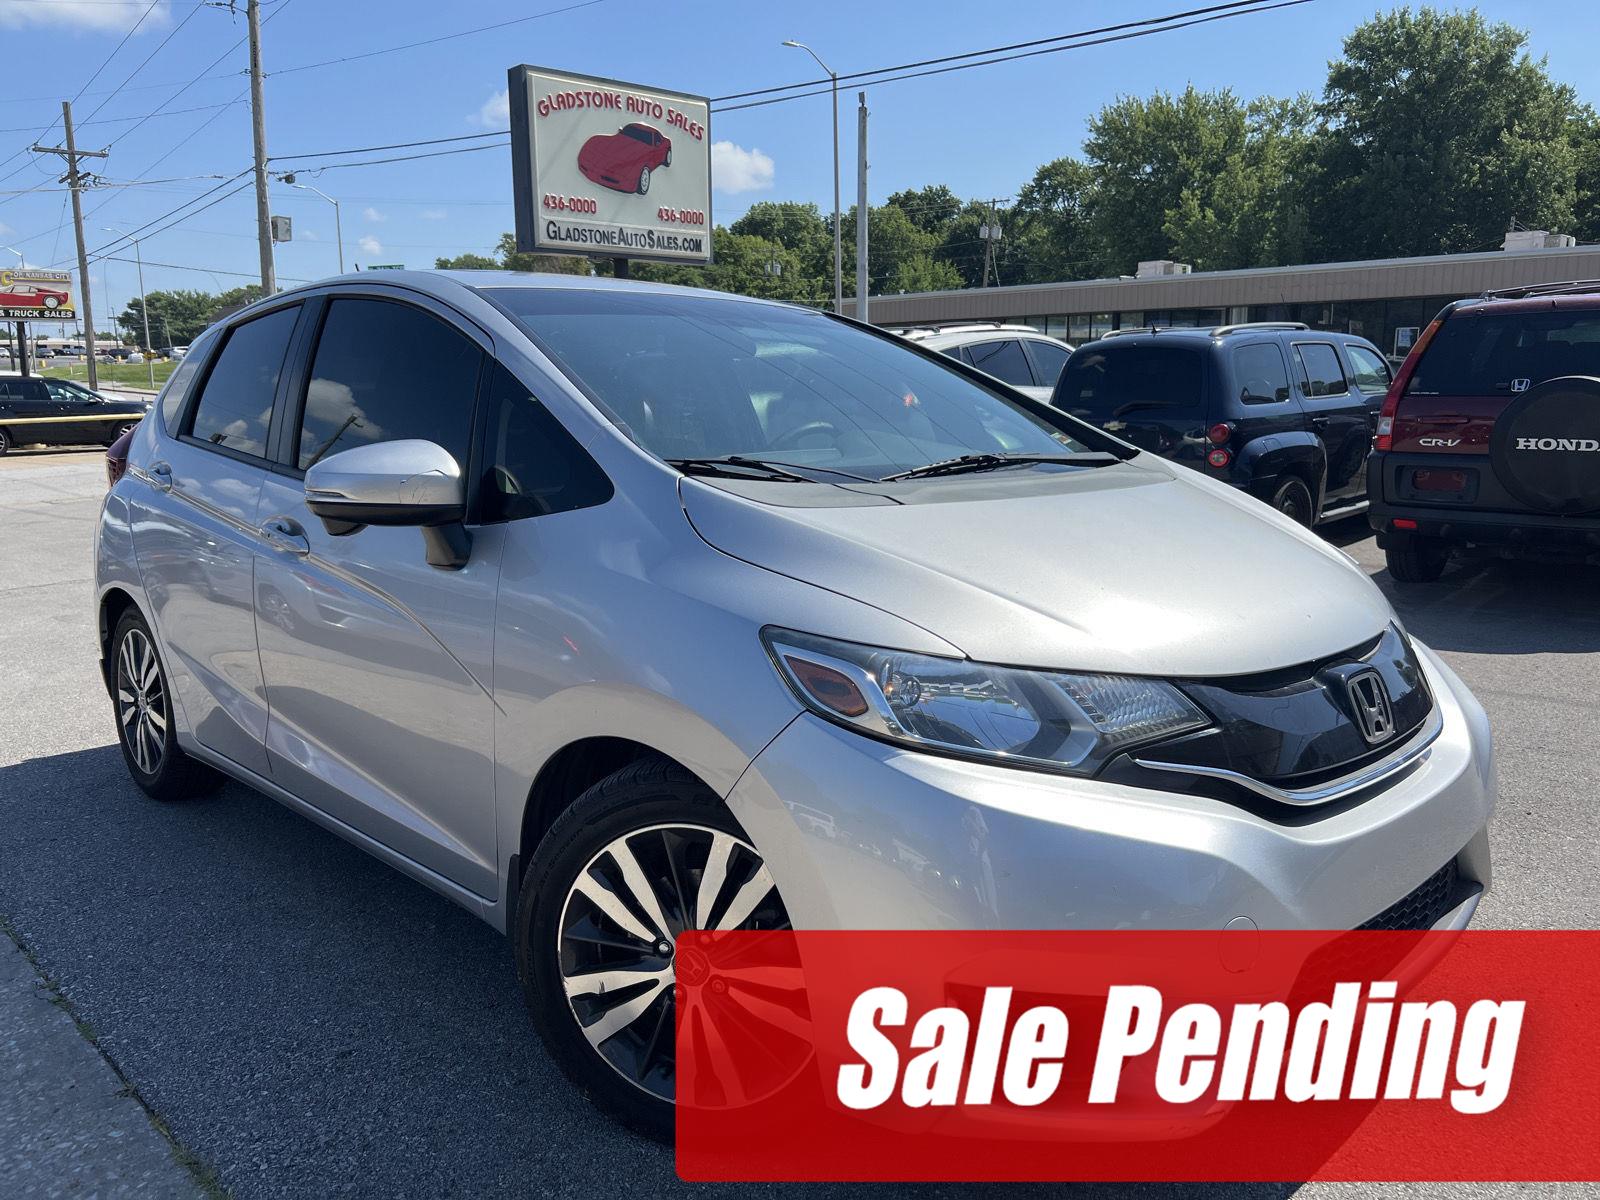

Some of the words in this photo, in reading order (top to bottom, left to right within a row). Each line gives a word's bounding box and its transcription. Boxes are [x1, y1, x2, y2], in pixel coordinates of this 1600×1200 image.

[537, 91, 622, 118] GLADSTONE
[626, 95, 663, 120] AUTO
[666, 108, 705, 142] SALES
[543, 193, 597, 215] 436-0000
[657, 206, 705, 226] 436-0000
[1419, 438, 1462, 447] CR-V
[1515, 437, 1600, 452] HOND
